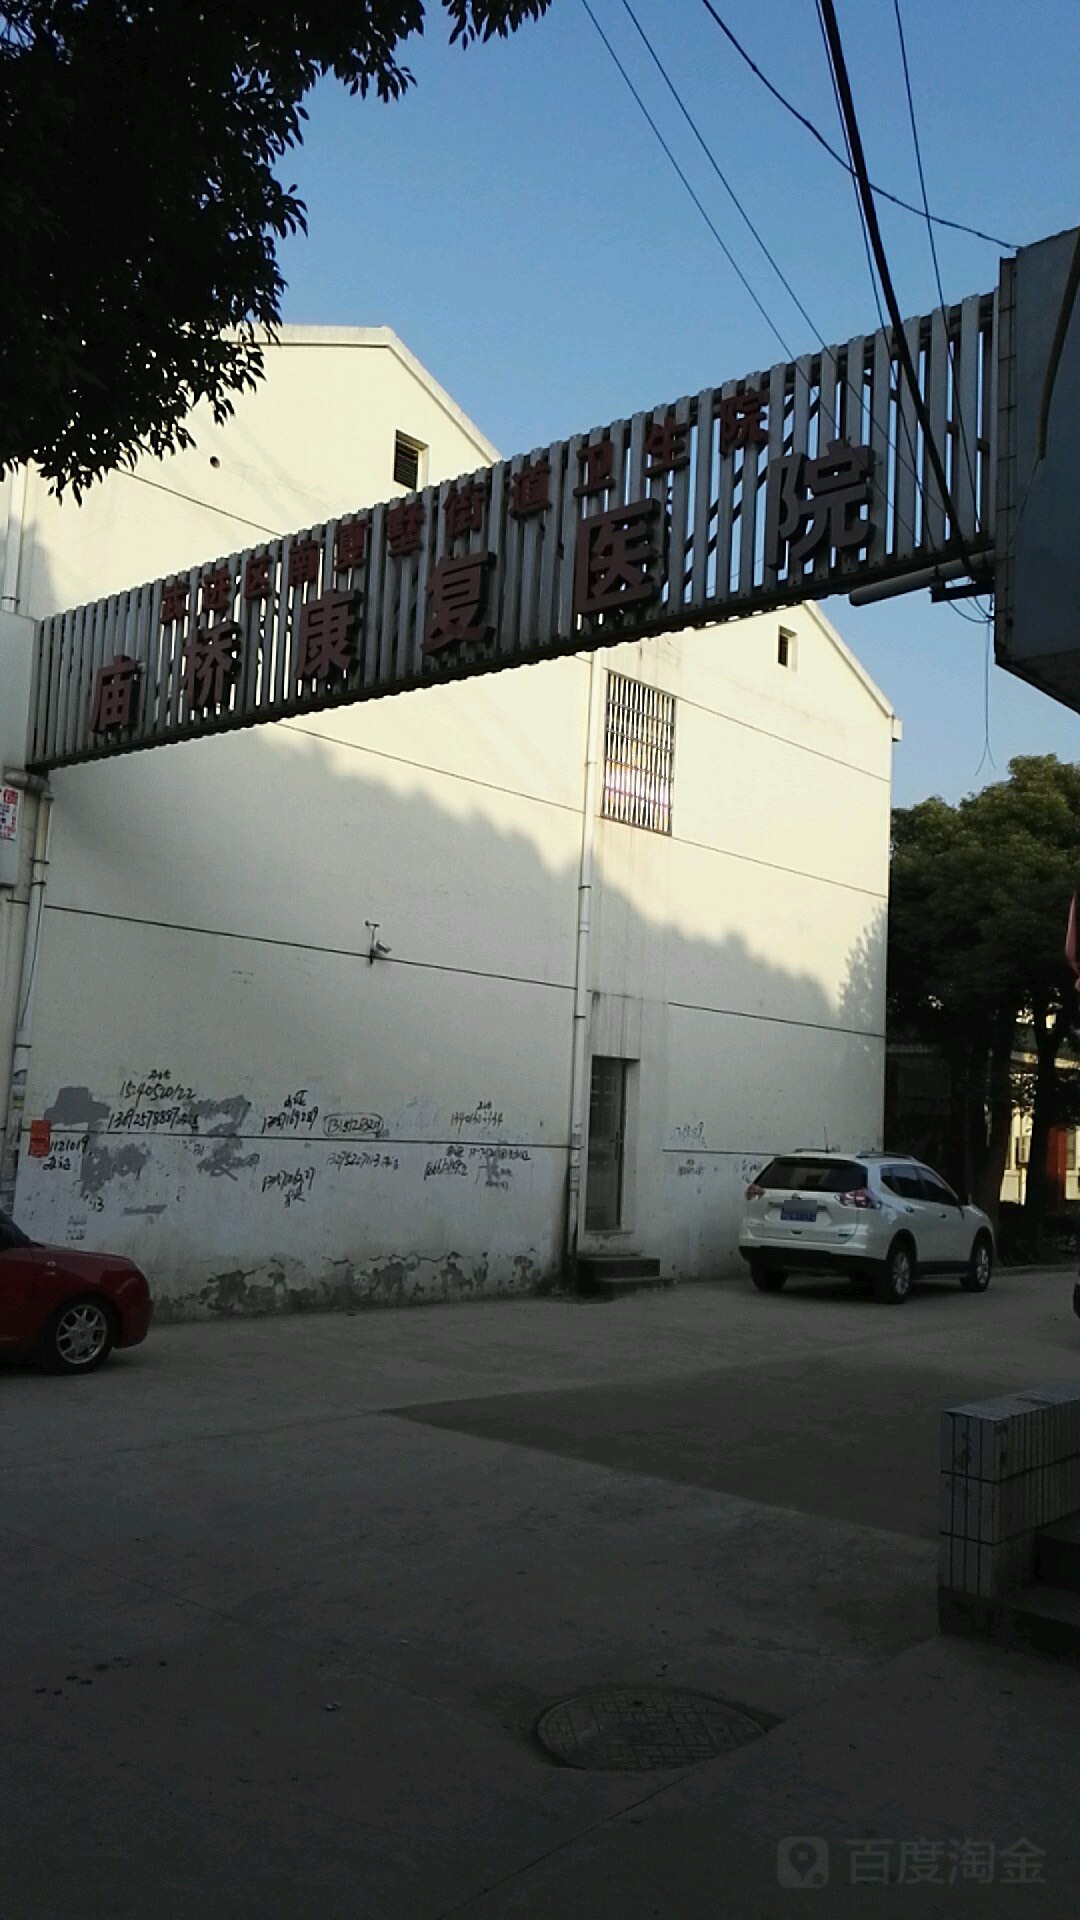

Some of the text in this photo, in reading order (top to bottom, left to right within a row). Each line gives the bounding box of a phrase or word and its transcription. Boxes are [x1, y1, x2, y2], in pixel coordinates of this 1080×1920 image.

[92, 440, 874, 735] 庙桥康复医院
